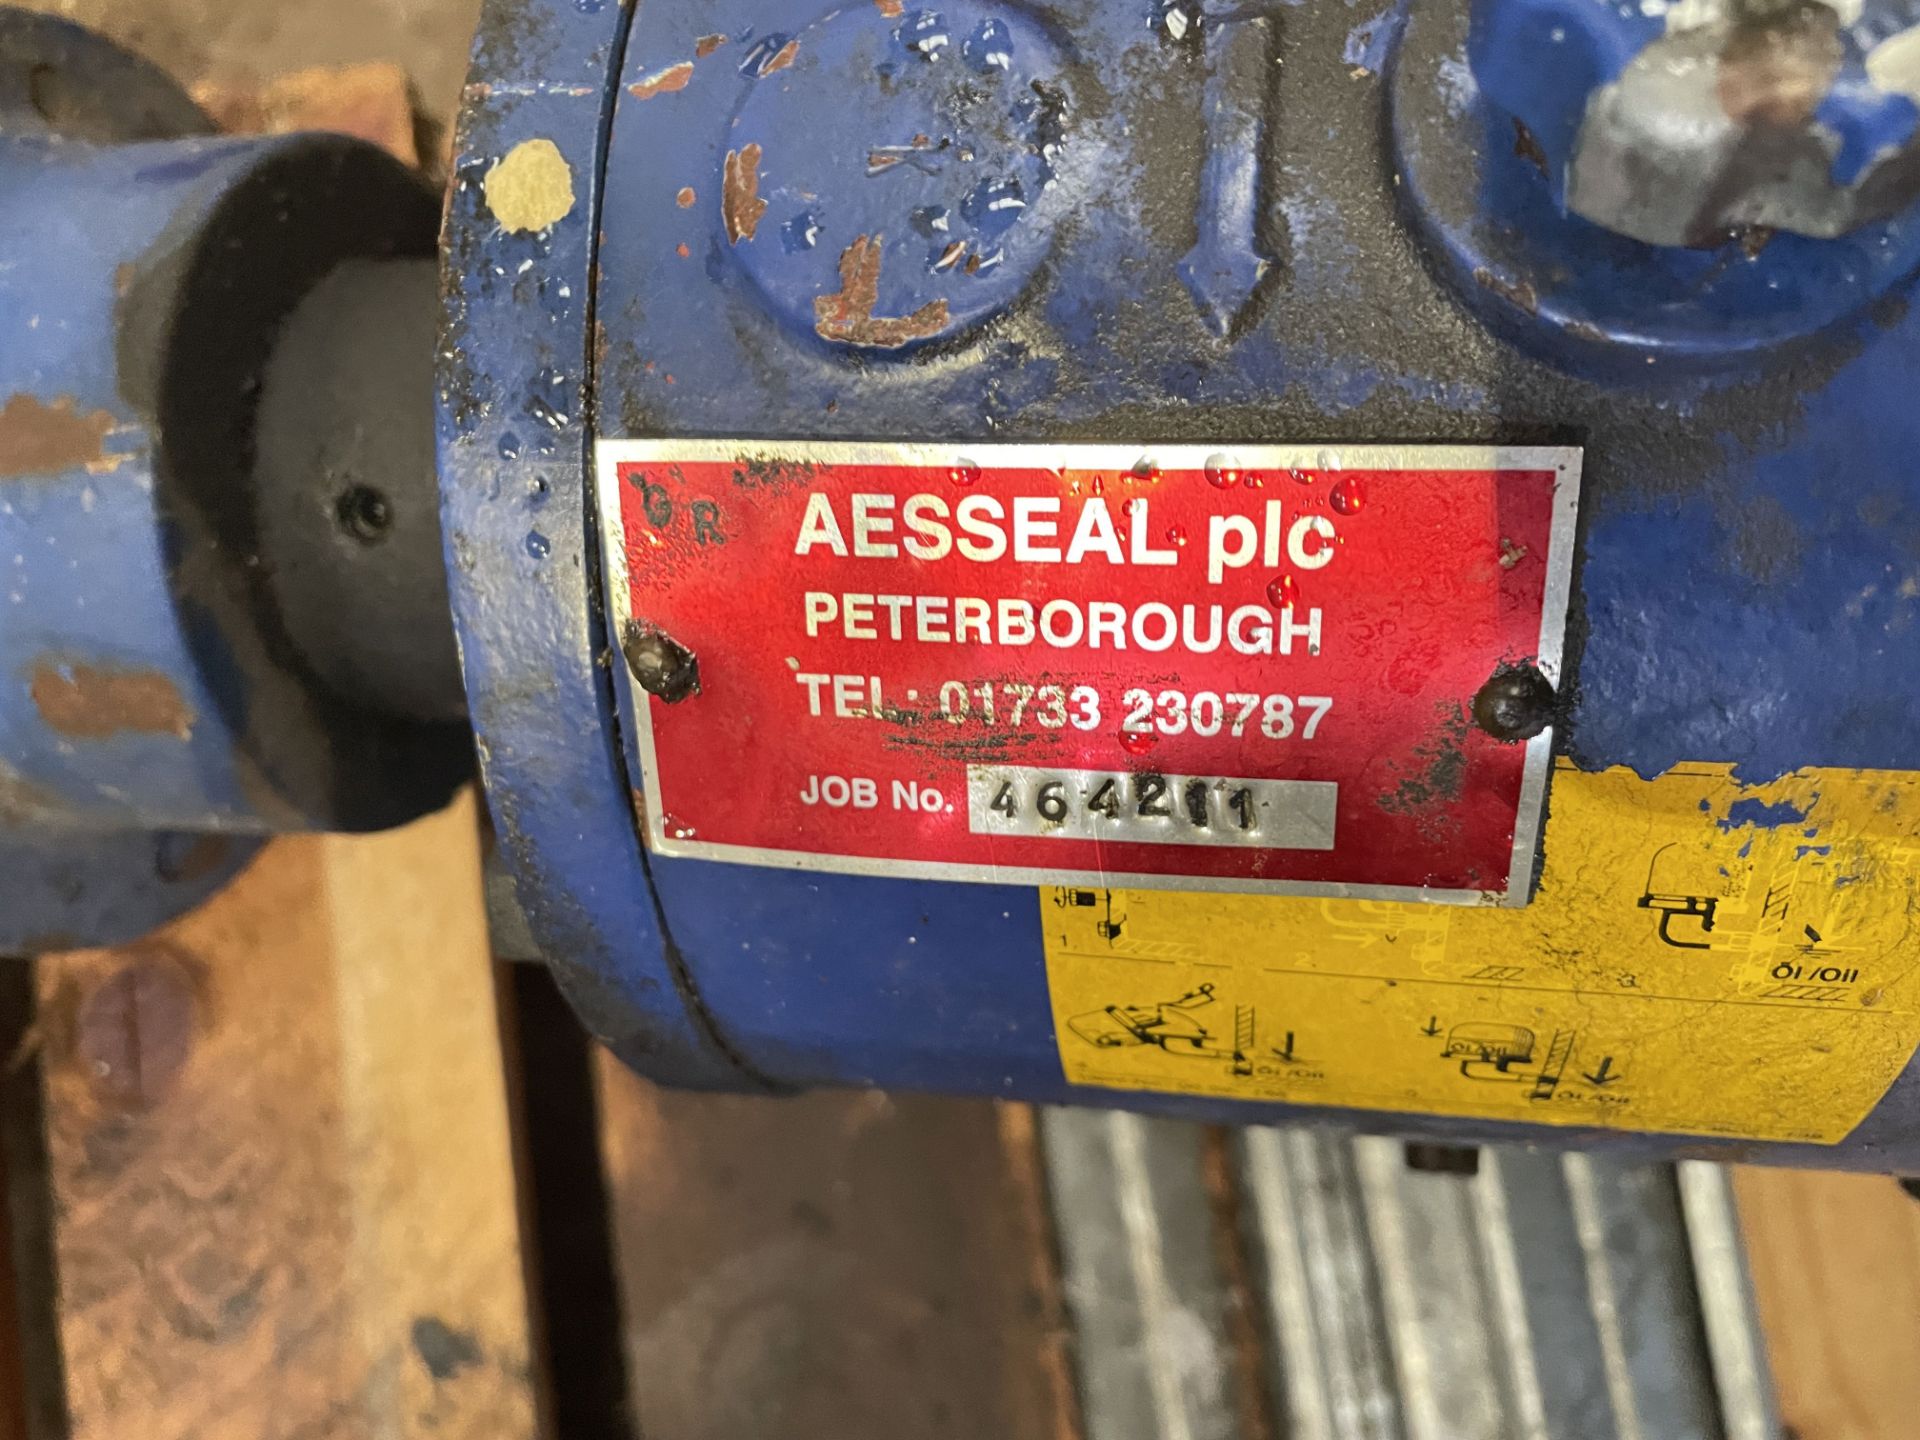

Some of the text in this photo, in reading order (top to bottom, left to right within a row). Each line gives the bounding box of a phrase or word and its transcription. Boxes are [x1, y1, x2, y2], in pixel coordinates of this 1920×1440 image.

[795, 493, 1336, 584] AESSEAL plc
[804, 591, 1323, 656] PETERBOROUGH
[939, 681, 1101, 731] 01733
[1121, 688, 1333, 739] 230787
[800, 774, 879, 809] JOB
[891, 779, 954, 813] No.
